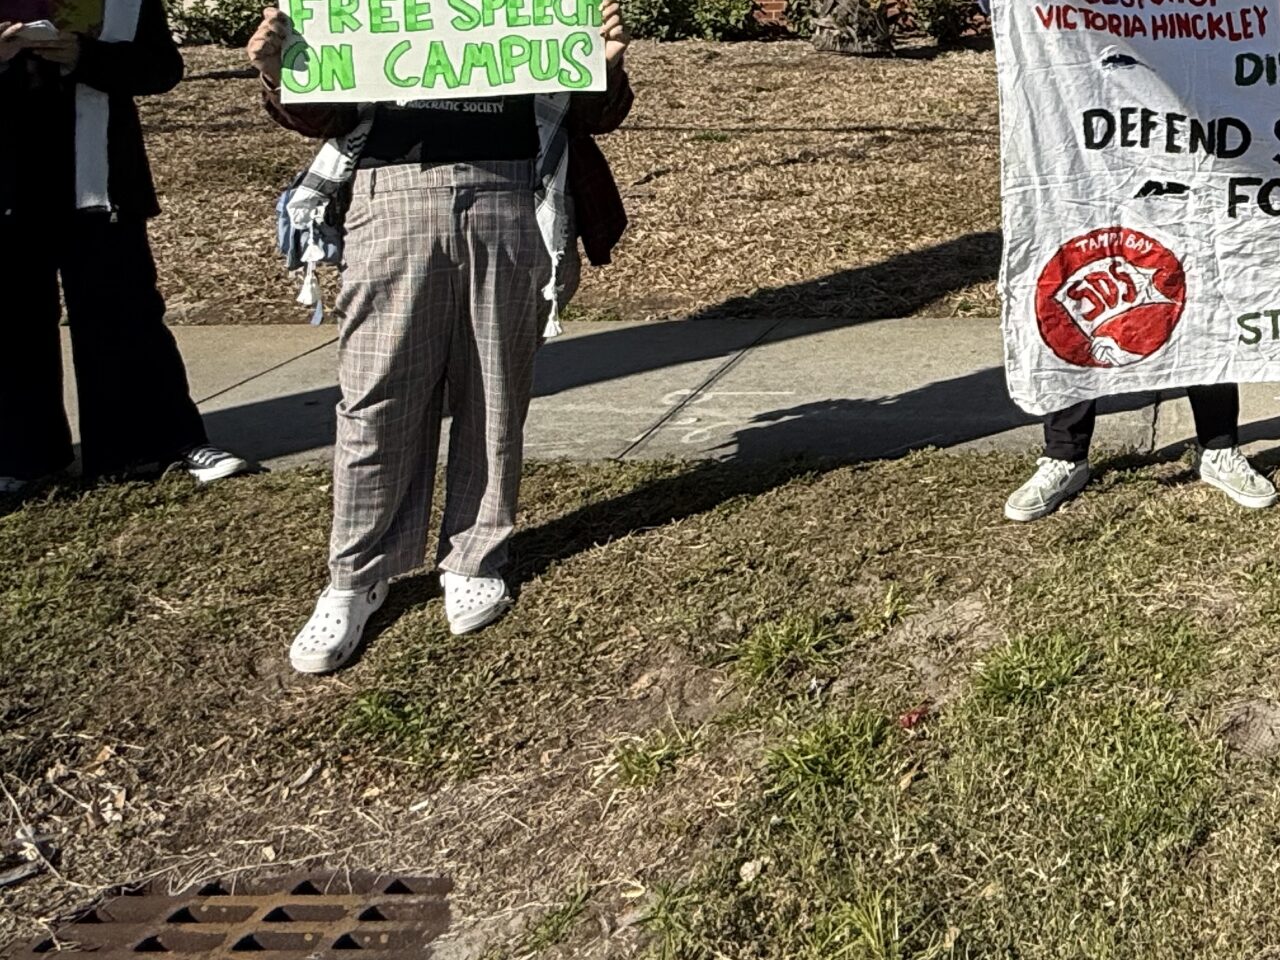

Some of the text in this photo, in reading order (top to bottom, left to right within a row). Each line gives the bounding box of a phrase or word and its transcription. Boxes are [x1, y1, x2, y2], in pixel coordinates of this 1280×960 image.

[1035, 5, 1268, 41] VICTORIA HINCKLEY
[281, 31, 594, 94] ON CAMPUS
[462, 101, 504, 114] SOCIETY
[1082, 106, 1252, 159] DEFEND
[1075, 232, 1153, 255] TAMPA BAY
[1066, 259, 1138, 321] SDS
